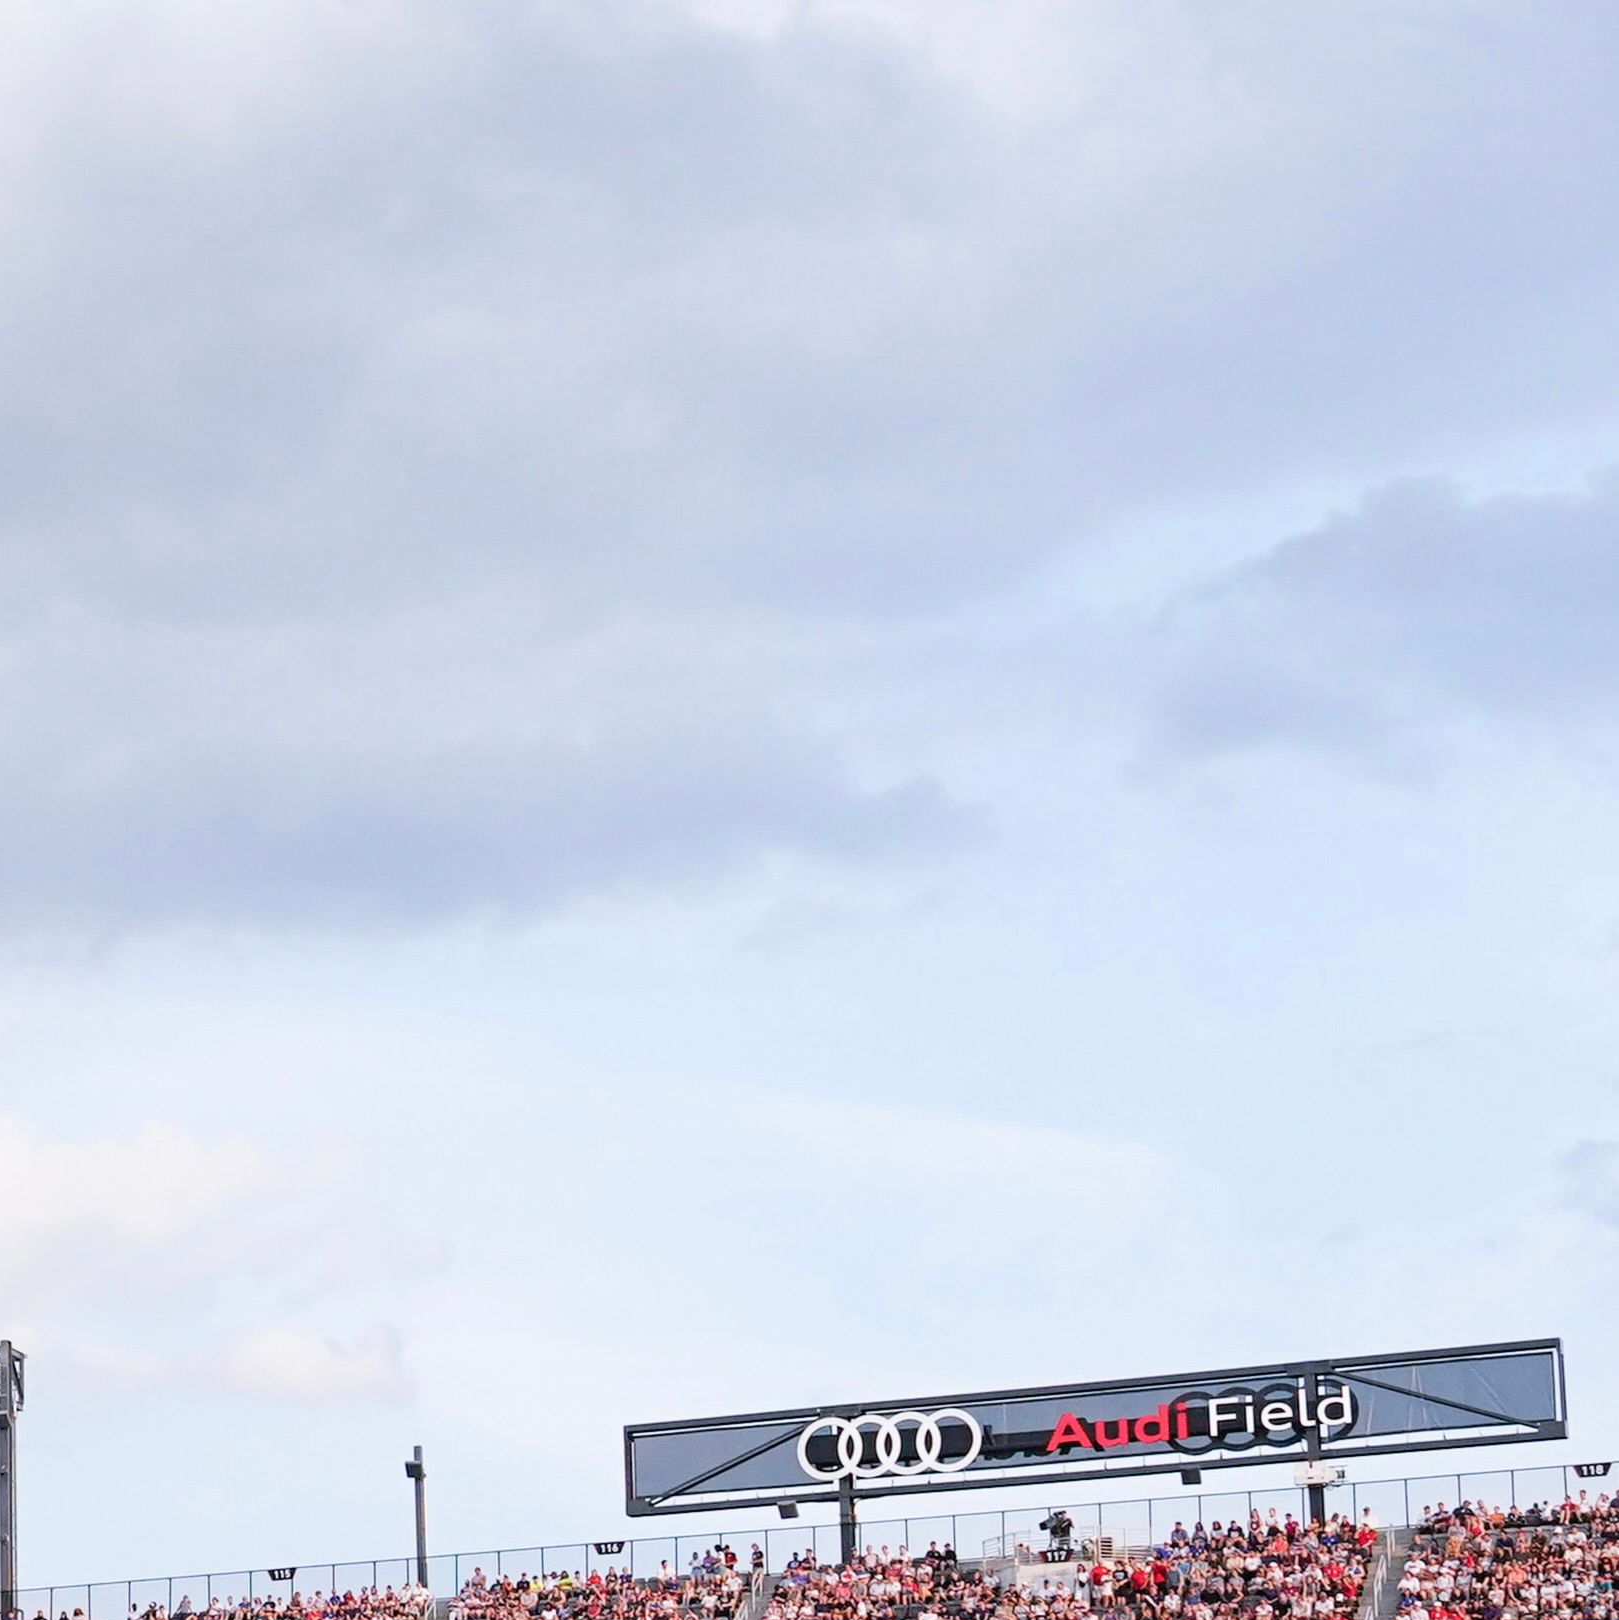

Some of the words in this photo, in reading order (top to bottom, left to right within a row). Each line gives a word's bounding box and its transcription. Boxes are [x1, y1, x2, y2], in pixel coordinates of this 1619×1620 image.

[1046, 1401, 1189, 1452] Audi
[1207, 1384, 1353, 1438] Field
[1582, 1464, 1605, 1476] 118
[600, 1542, 620, 1554] 116
[1045, 1551, 1067, 1562] 117
[273, 1569, 292, 1580] 115
